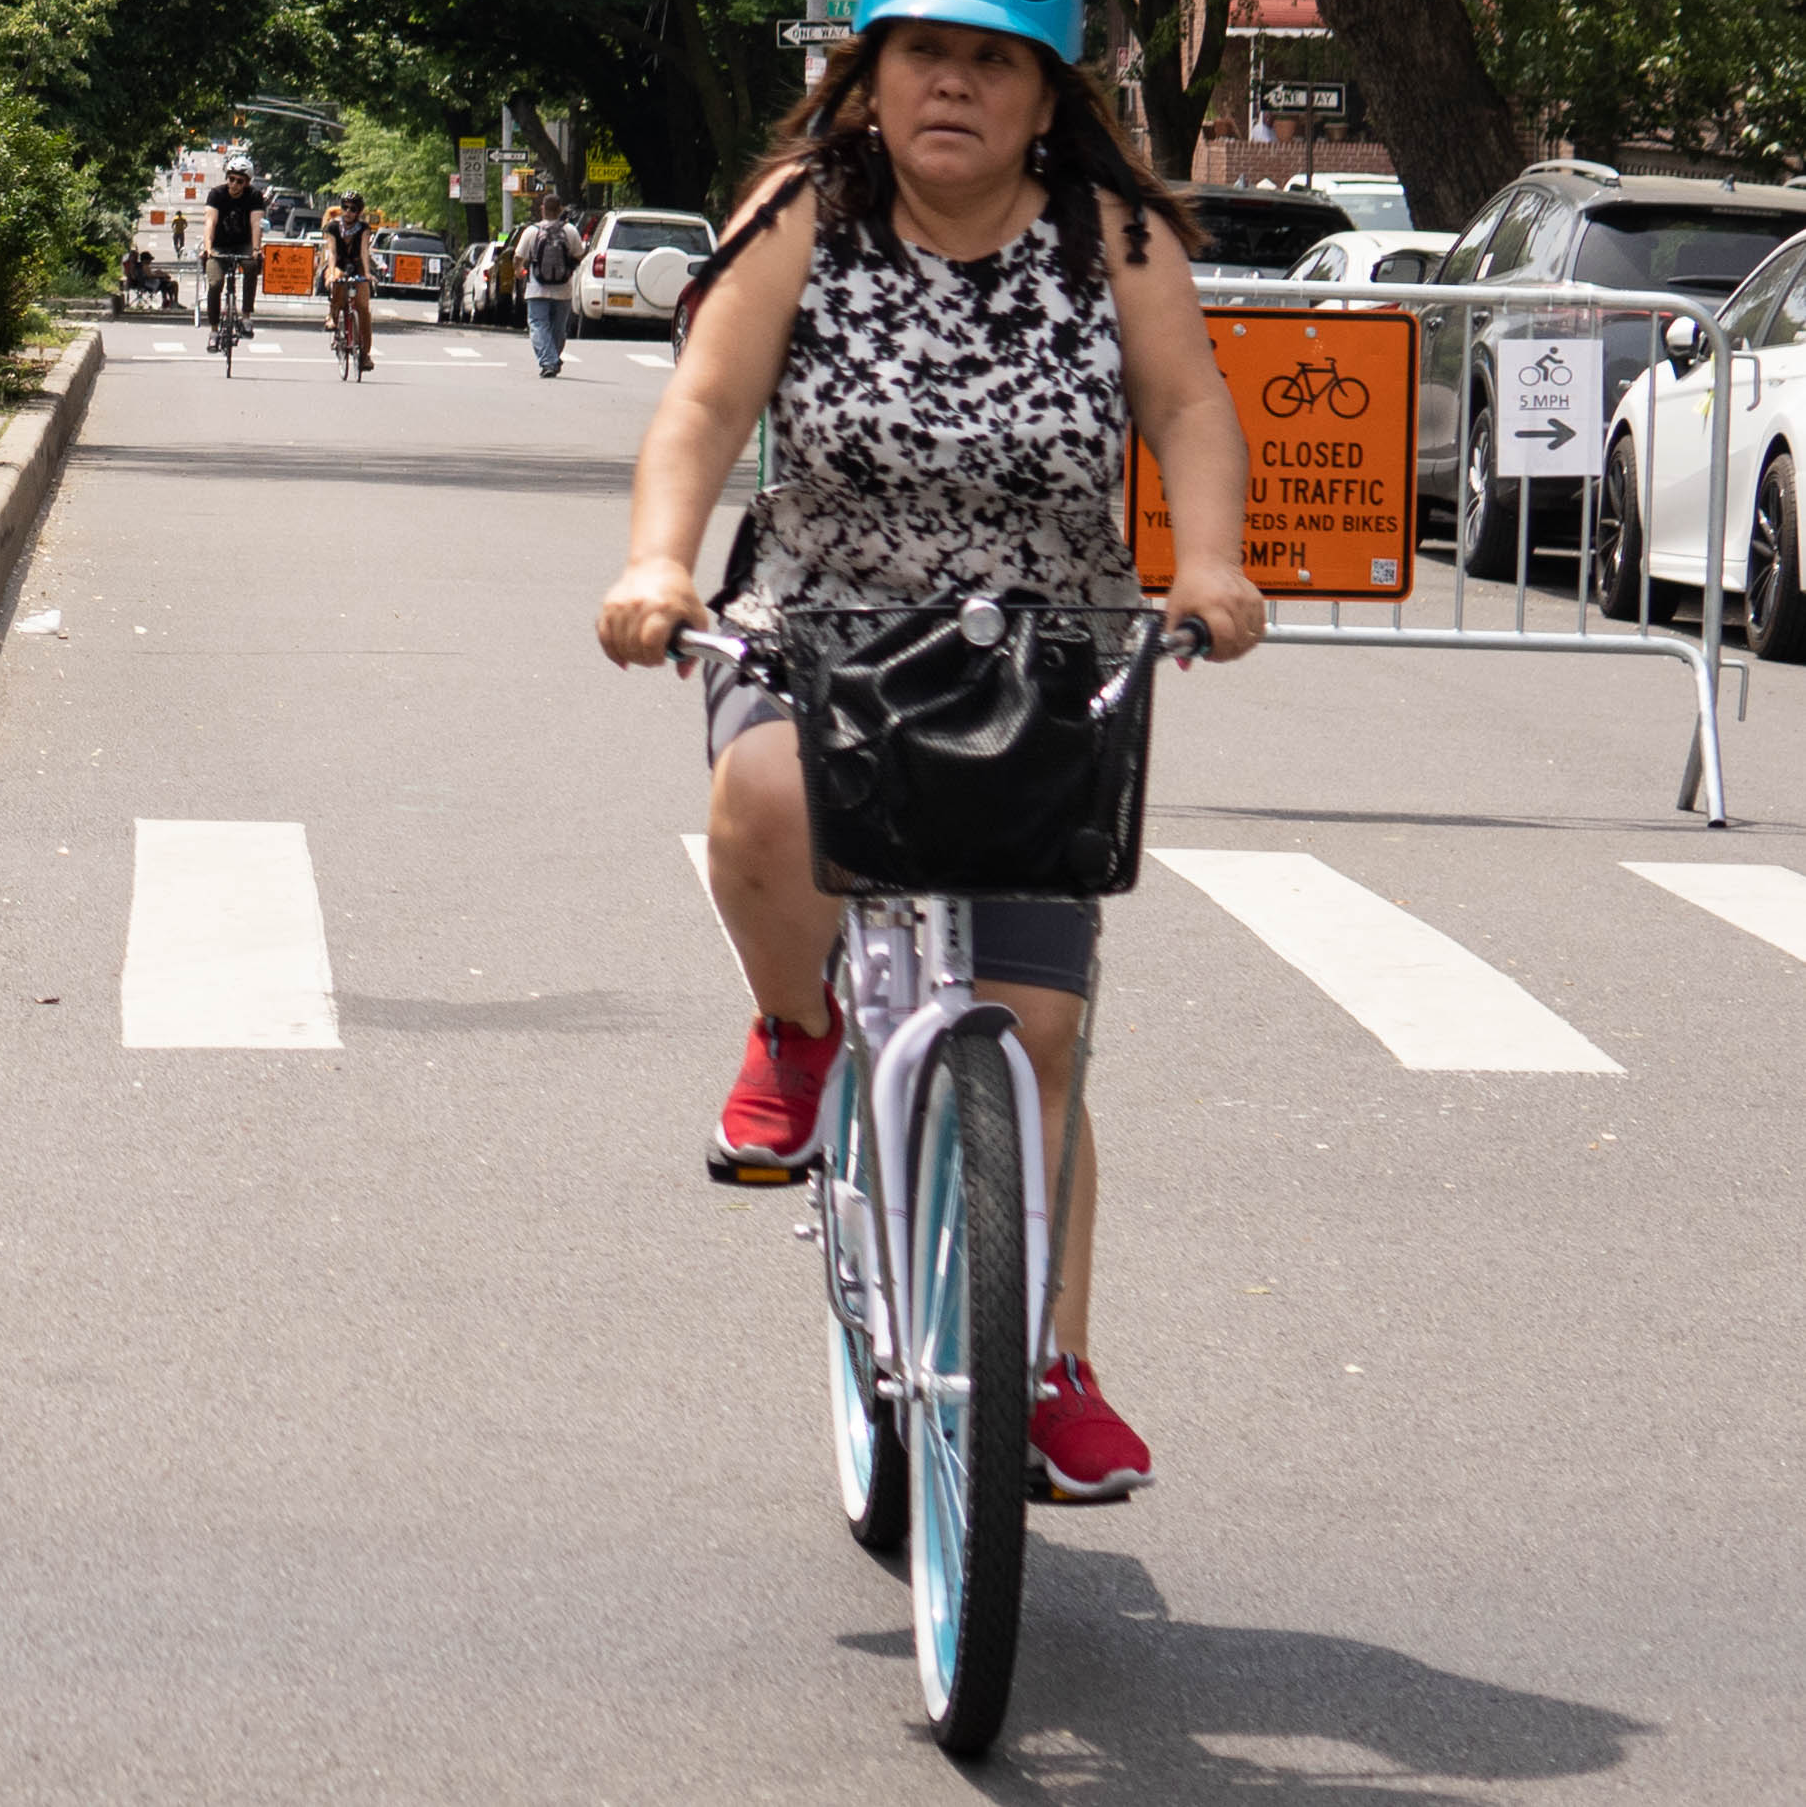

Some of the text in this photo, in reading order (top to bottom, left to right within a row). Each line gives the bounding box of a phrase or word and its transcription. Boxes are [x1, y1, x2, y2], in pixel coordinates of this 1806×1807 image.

[834, 1, 851, 14] 76
[792, 28, 845, 39] ONE WAY
[464, 162, 482, 171] 20
[1520, 394, 1569, 408] 5 MPH
[1262, 441, 1363, 468] CLOSED
[1279, 478, 1384, 506] TRAFFIC
[1294, 515, 1335, 531] AND
[1342, 515, 1398, 533] BIKES
